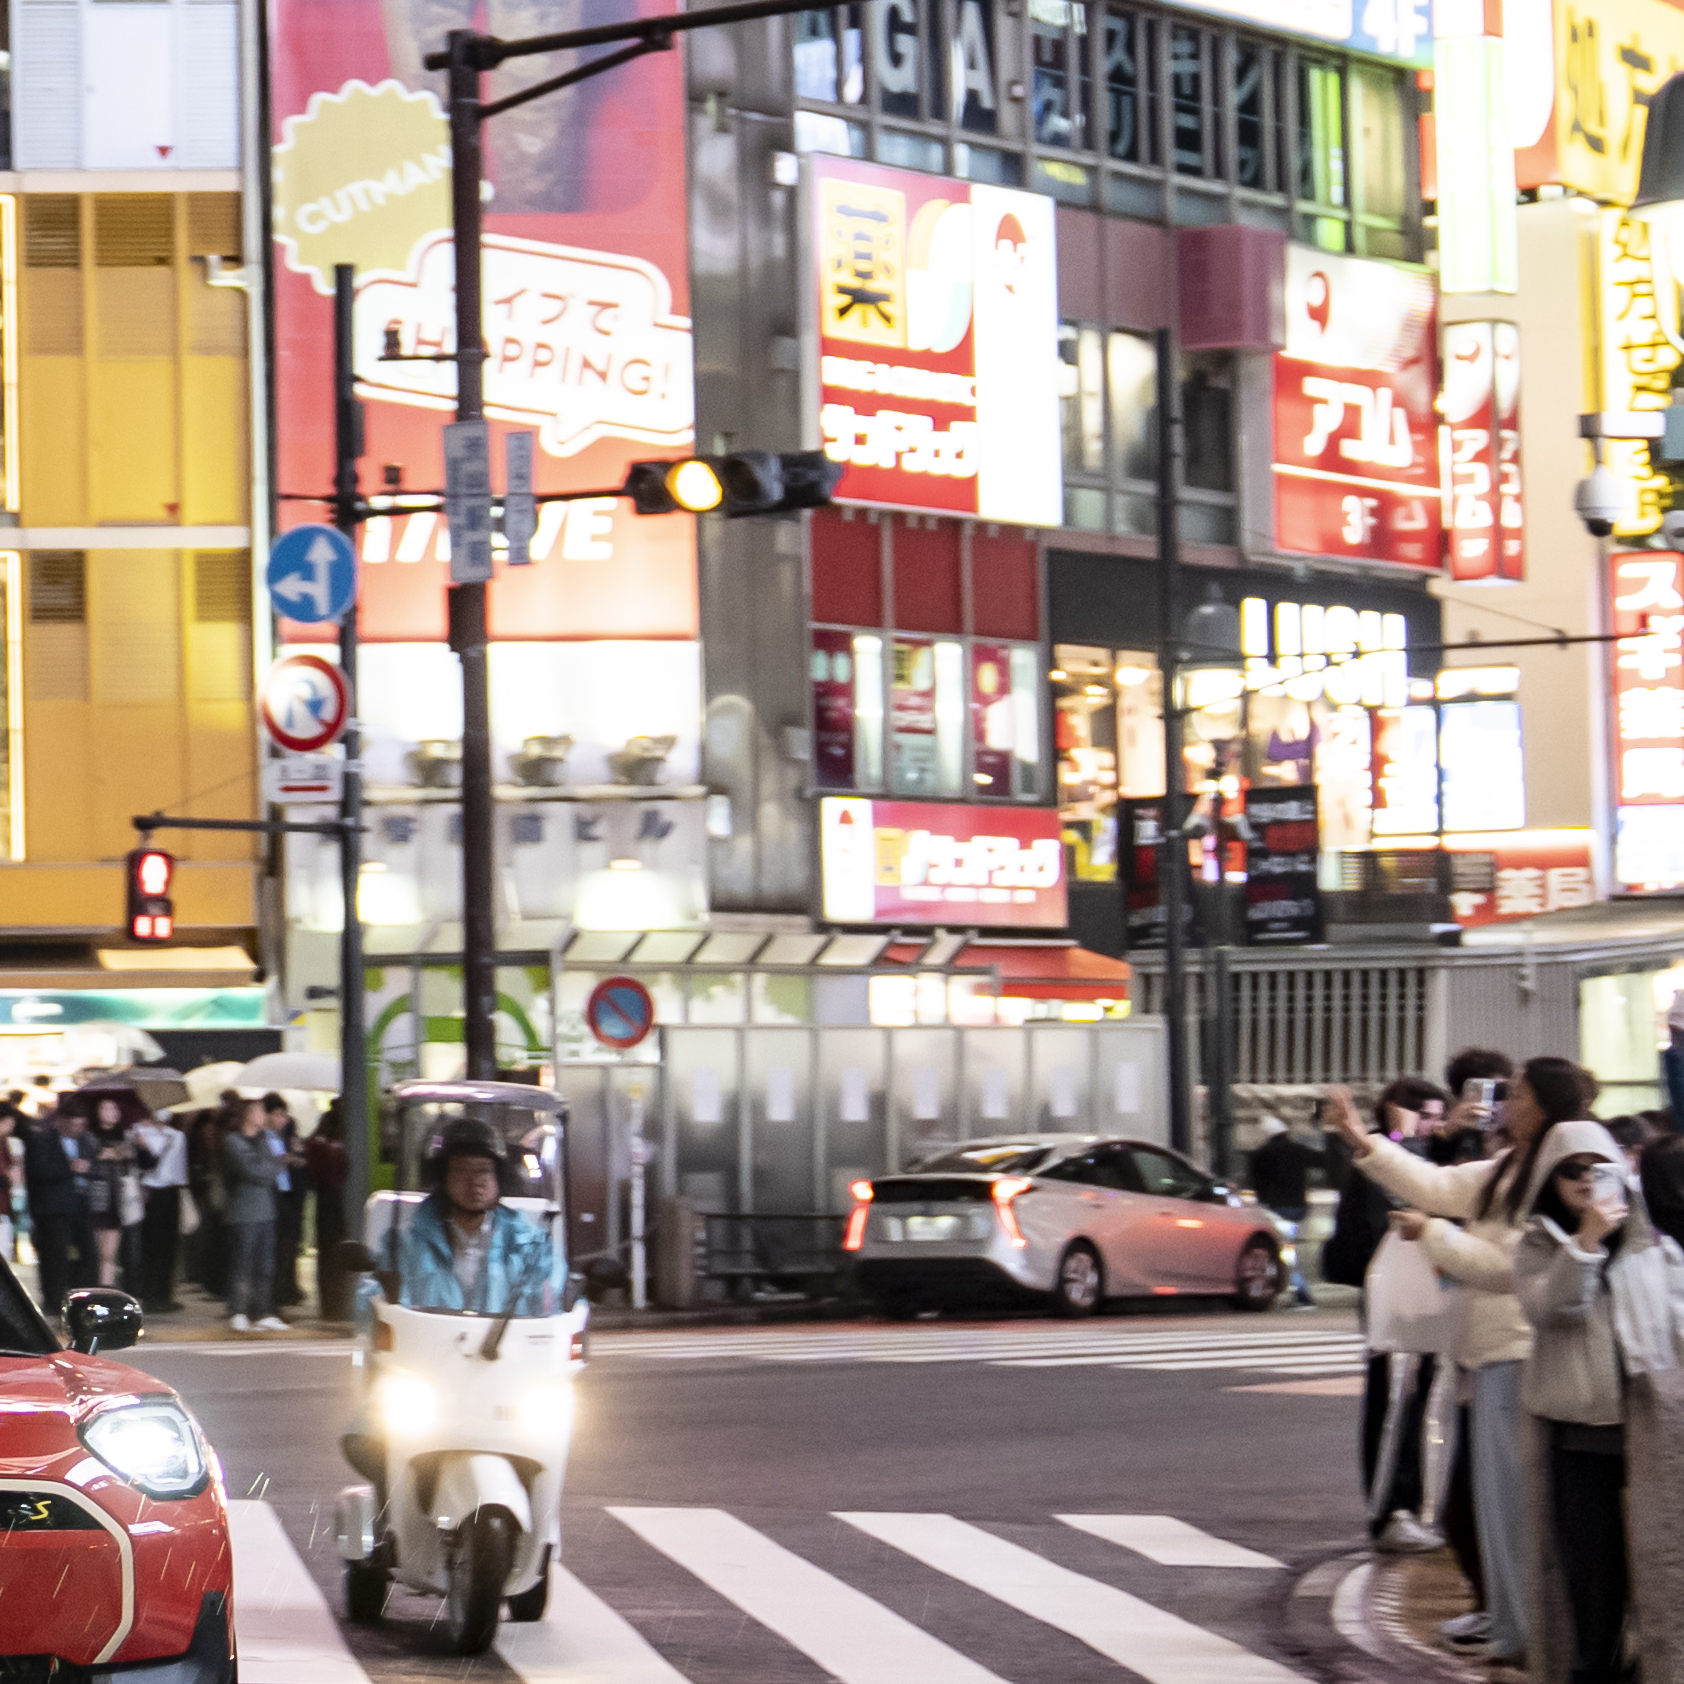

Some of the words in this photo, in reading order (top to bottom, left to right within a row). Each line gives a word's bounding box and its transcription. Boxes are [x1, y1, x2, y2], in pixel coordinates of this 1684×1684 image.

[382, 318, 672, 399] HPPING!
[1301, 375, 1414, 468] アコム
[1341, 495, 1380, 545] 3F
[1452, 429, 1494, 528] アコム
